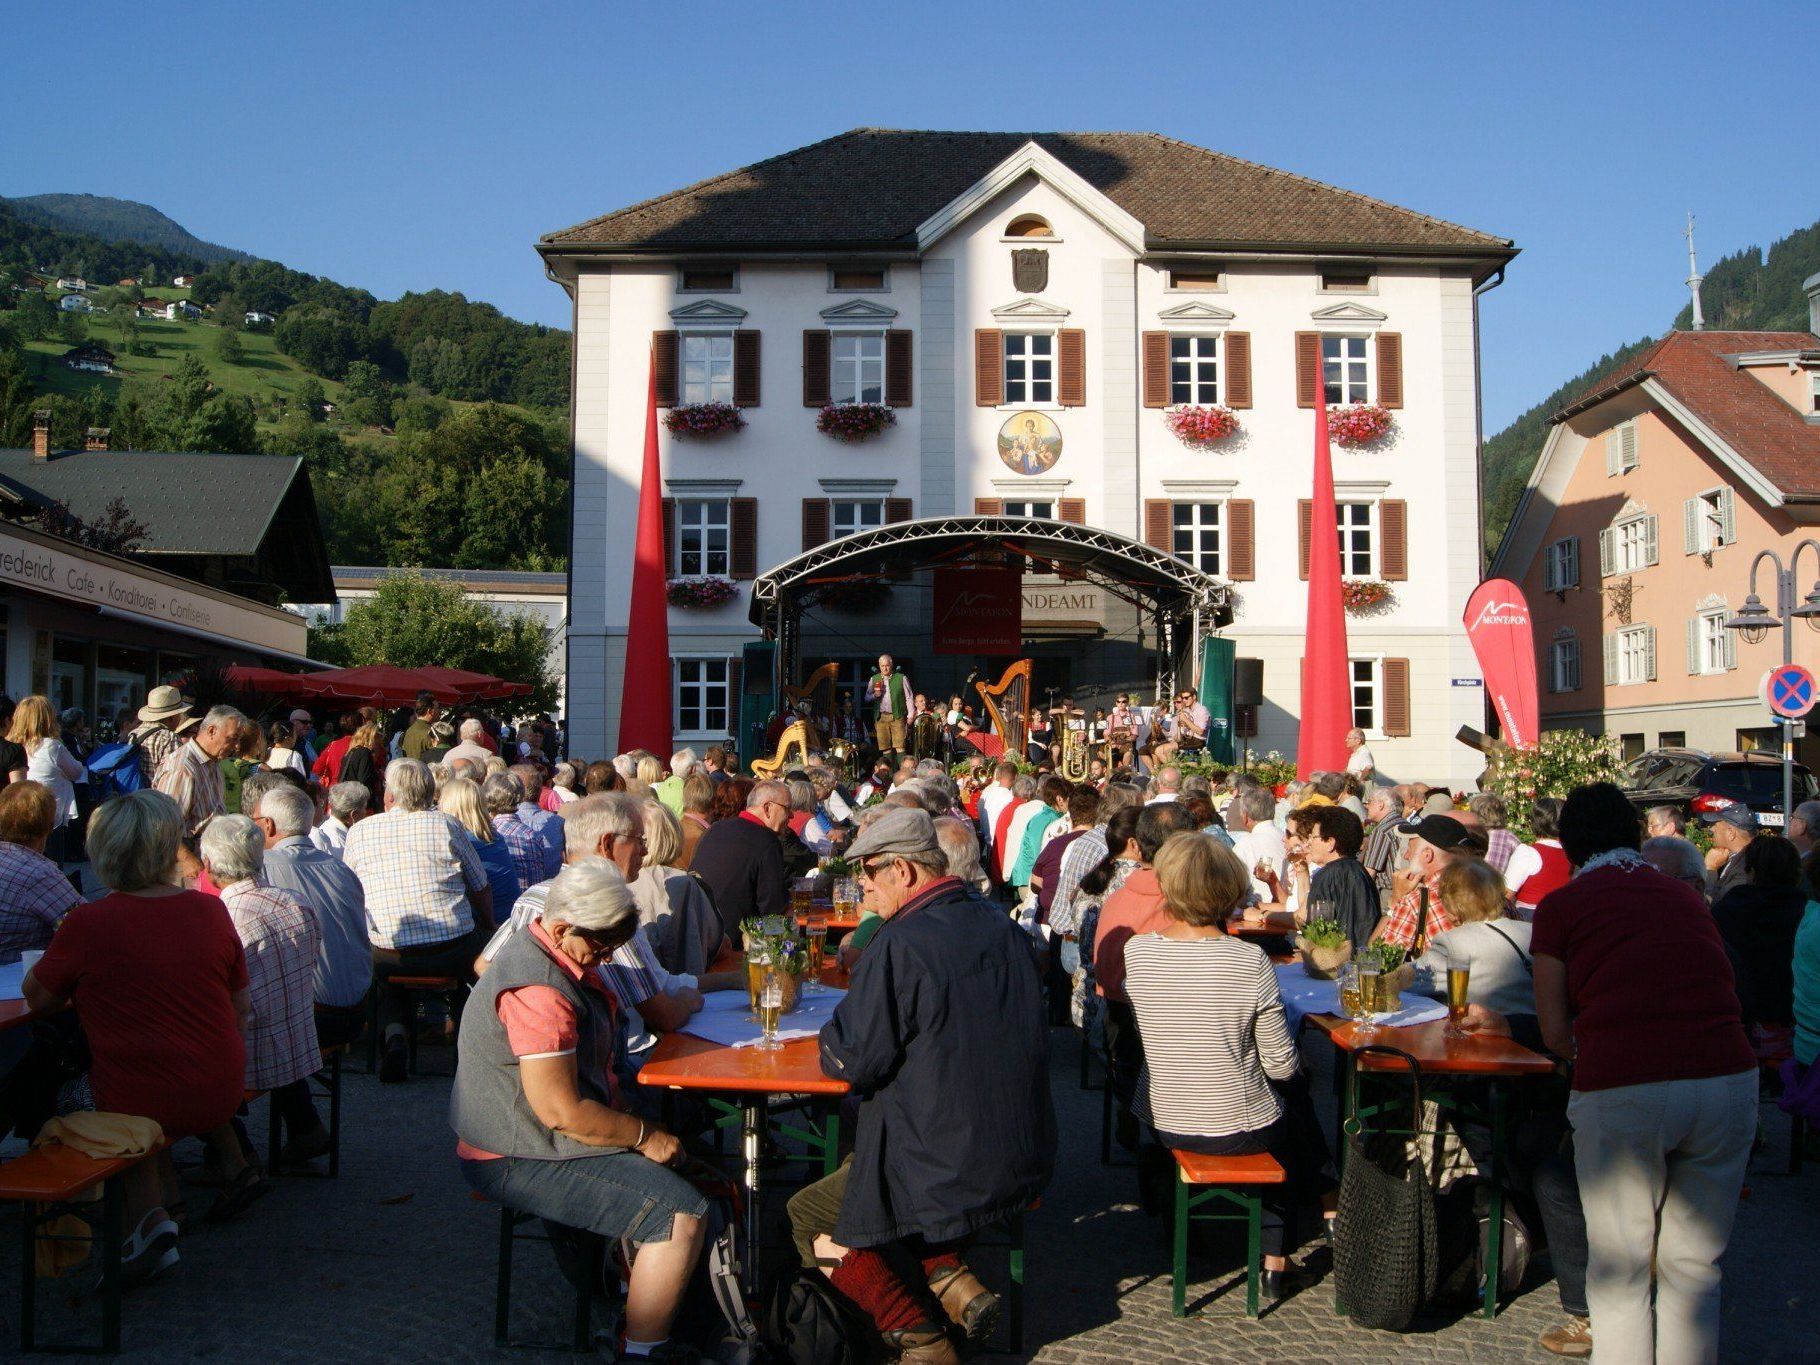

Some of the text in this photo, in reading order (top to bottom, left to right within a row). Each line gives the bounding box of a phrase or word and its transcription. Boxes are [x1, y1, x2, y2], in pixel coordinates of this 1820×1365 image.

[0, 549, 55, 583] rederick
[67, 569, 95, 593] Cafe
[108, 580, 156, 610] Konditorei
[1021, 594, 1096, 608] NDEAMT
[1483, 615, 1526, 625] MONTAFON
